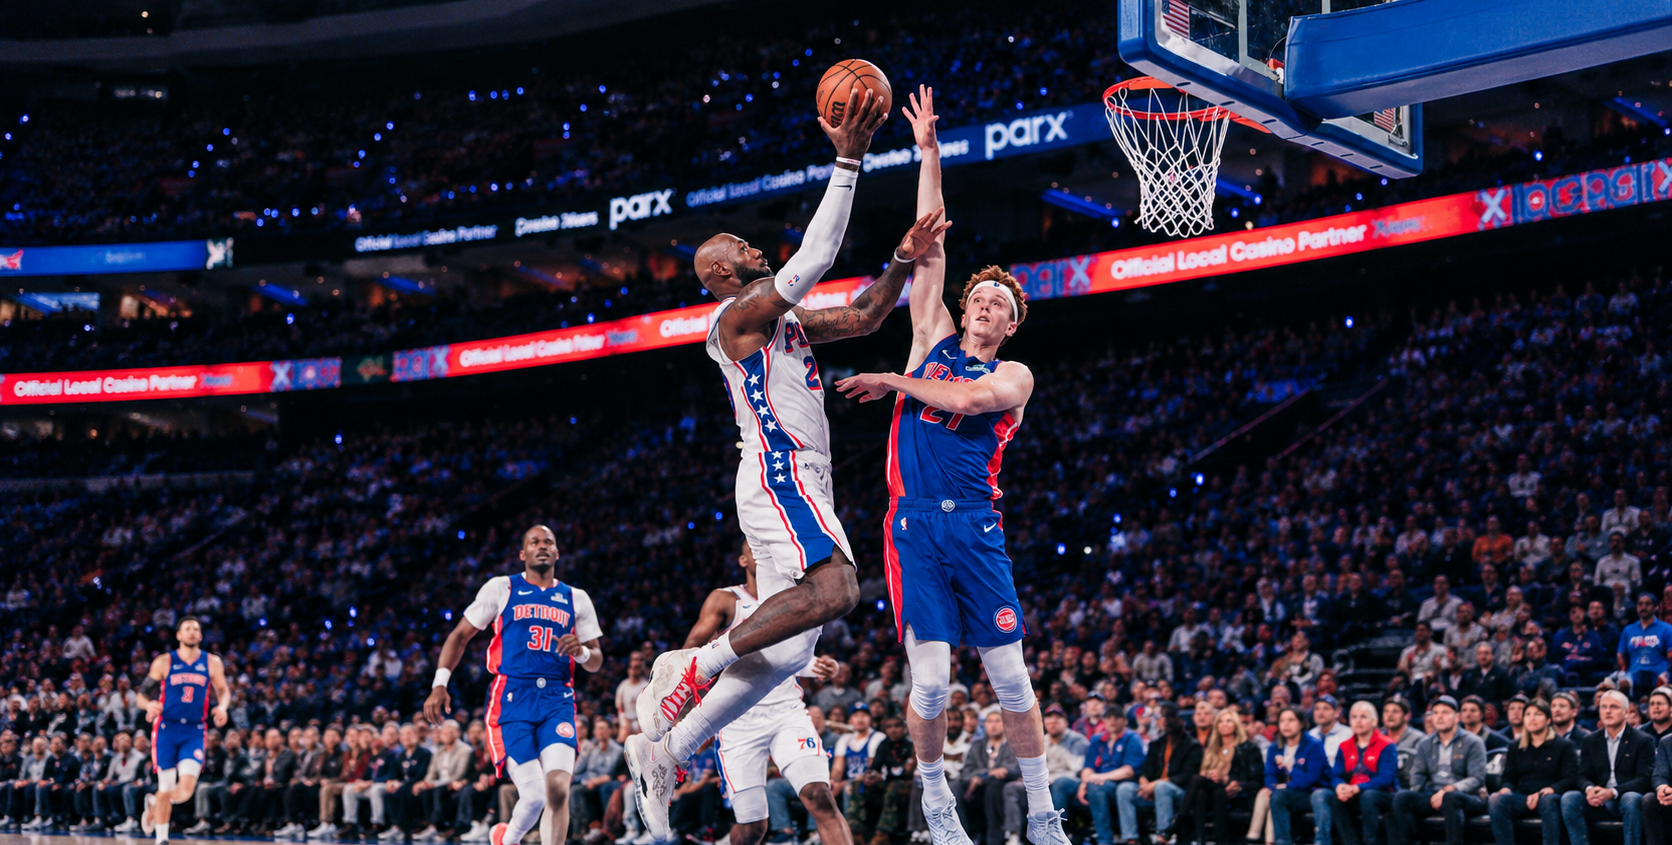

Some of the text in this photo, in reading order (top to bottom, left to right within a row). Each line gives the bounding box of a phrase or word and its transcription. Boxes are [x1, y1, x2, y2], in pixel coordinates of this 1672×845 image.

[984, 111, 1068, 160] parx
[609, 188, 673, 230] parx
[1110, 252, 1175, 280] Official
[1177, 244, 1228, 270] Local
[1230, 236, 1296, 262] Casino
[1298, 224, 1367, 251] Partner
[512, 603, 571, 628] DETROIT
[527, 625, 553, 653] 31
[797, 736, 816, 750] 76
